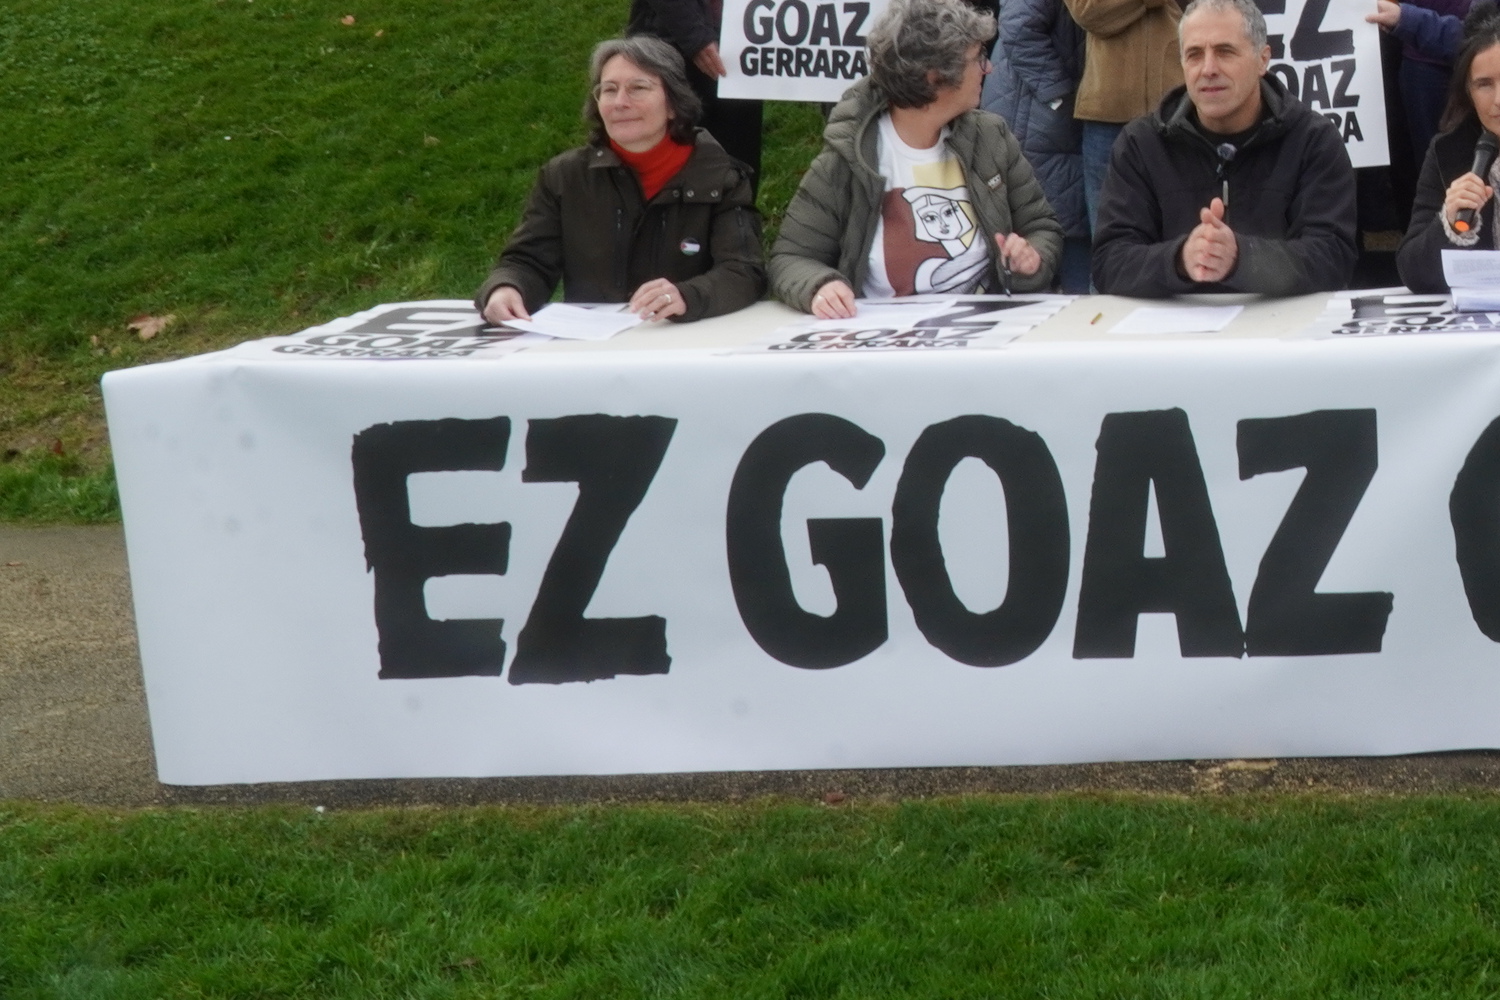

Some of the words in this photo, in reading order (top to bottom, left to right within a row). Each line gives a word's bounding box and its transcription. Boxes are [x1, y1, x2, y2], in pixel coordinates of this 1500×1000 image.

[740, 46, 868, 79] GERRARA
[305, 334, 510, 350] GOAZ
[789, 328, 996, 342] GOAZ
[352, 413, 678, 686] EZ
[726, 407, 1394, 670] GOAZ
